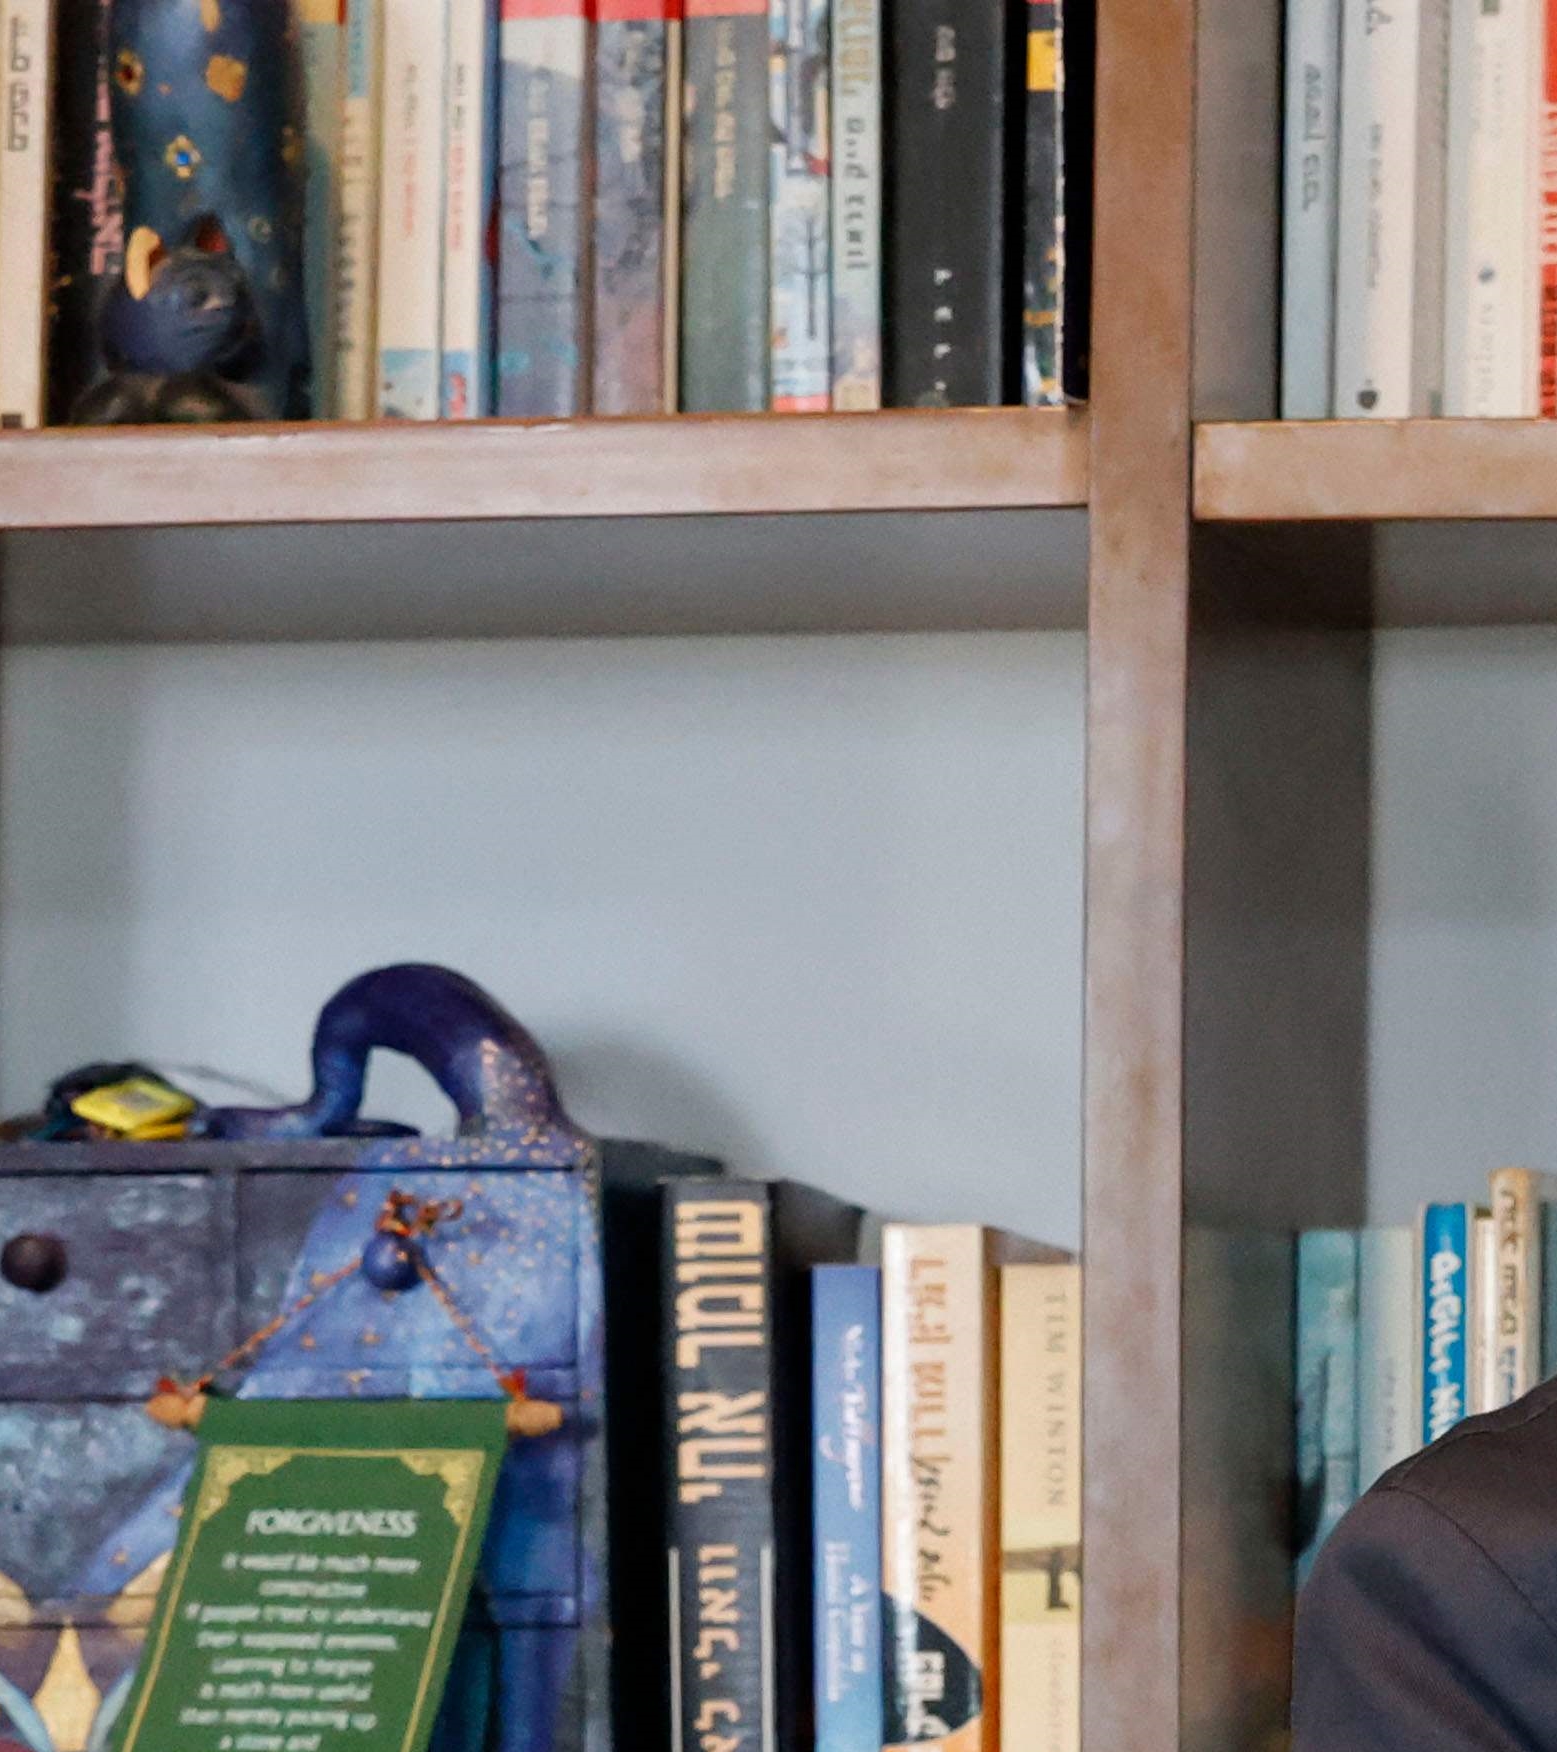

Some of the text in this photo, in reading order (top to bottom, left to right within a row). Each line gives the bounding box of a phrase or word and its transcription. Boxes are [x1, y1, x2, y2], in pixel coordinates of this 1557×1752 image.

[674, 1199, 765, 1503] שומר אחי
[1046, 1292, 1068, 1353] TIM
[245, 1509, 418, 1537] FORGIVENESS
[690, 1542, 738, 1680] וואלי
